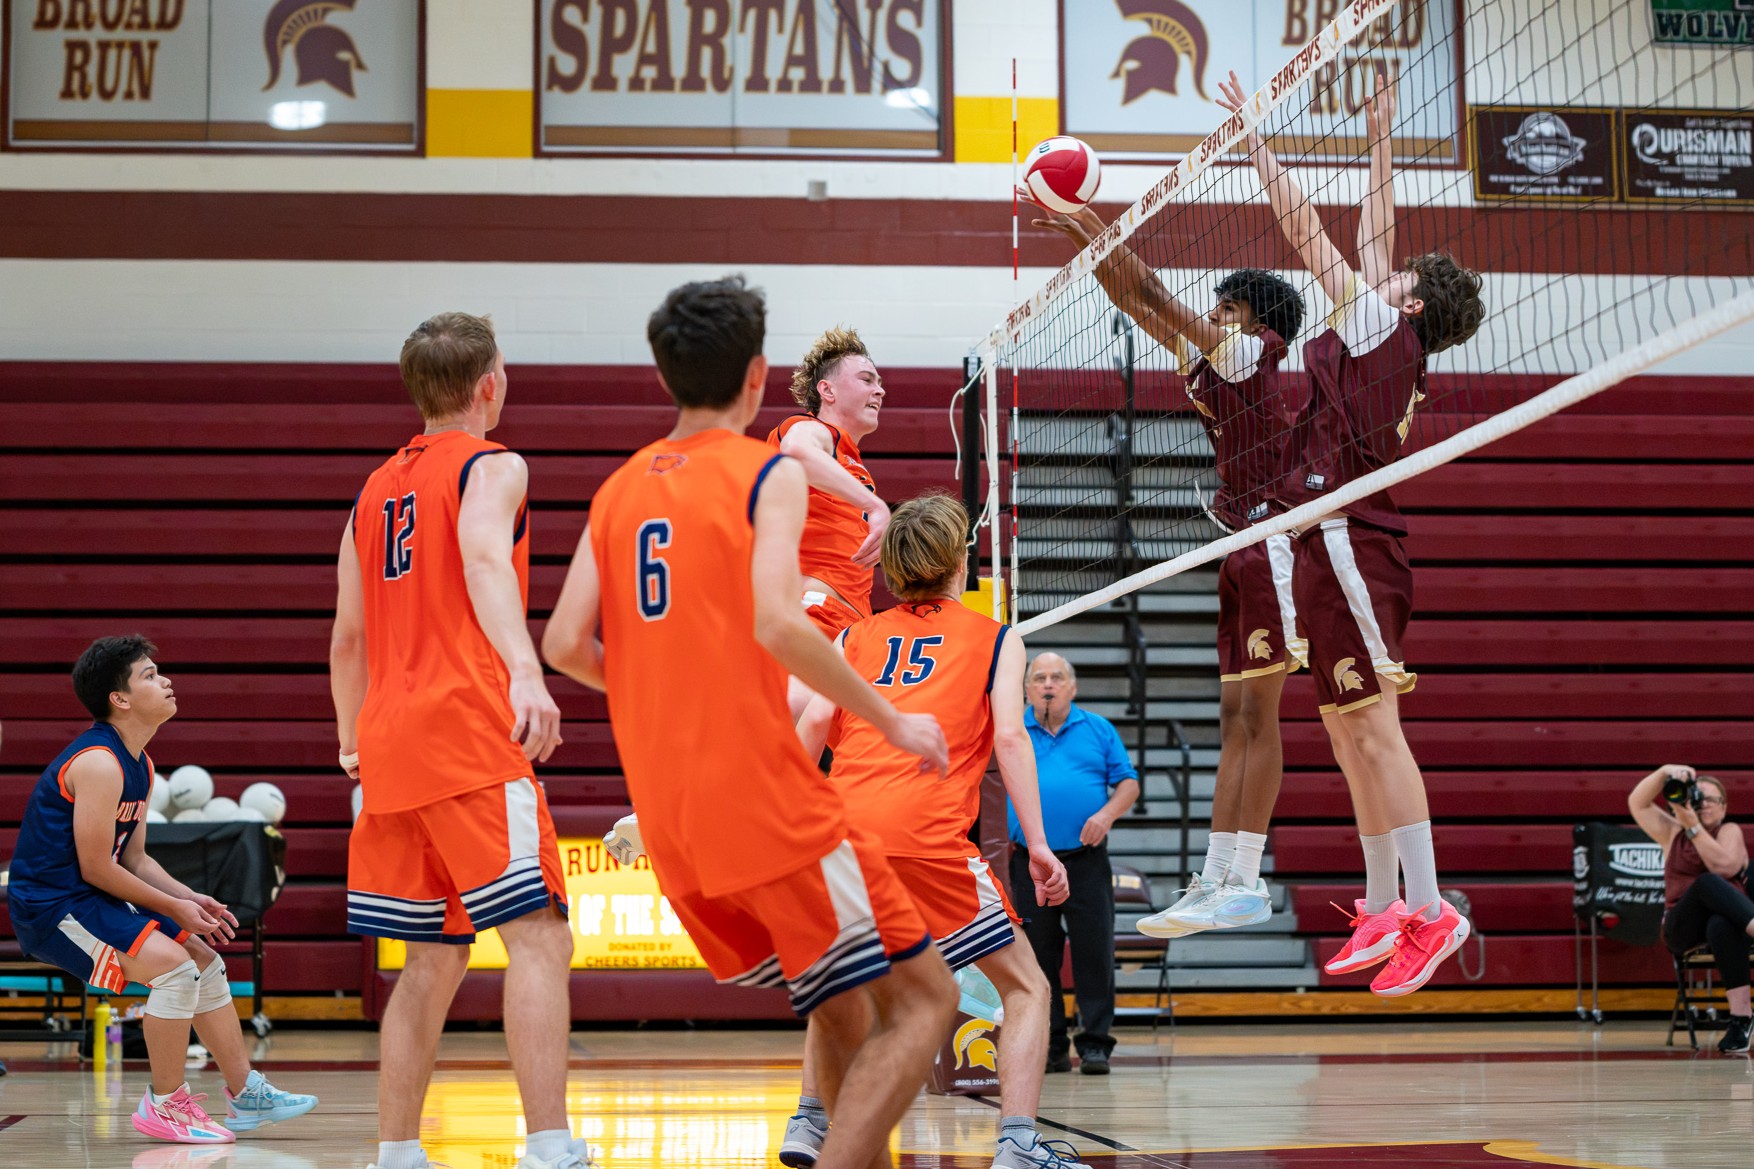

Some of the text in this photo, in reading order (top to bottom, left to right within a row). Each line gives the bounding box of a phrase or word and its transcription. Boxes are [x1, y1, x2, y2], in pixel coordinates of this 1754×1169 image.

[59, 39, 159, 101] RUN
[546, 0, 926, 94] SPARTANS
[1271, 36, 1322, 101] SPARTANS
[382, 491, 416, 581] 12
[636, 518, 673, 622] 6
[873, 635, 944, 687] 15
[611, 894, 654, 936] THE
[585, 956, 697, 967] CHEERS SPORTS
[608, 942, 672, 951] DONATED BY
